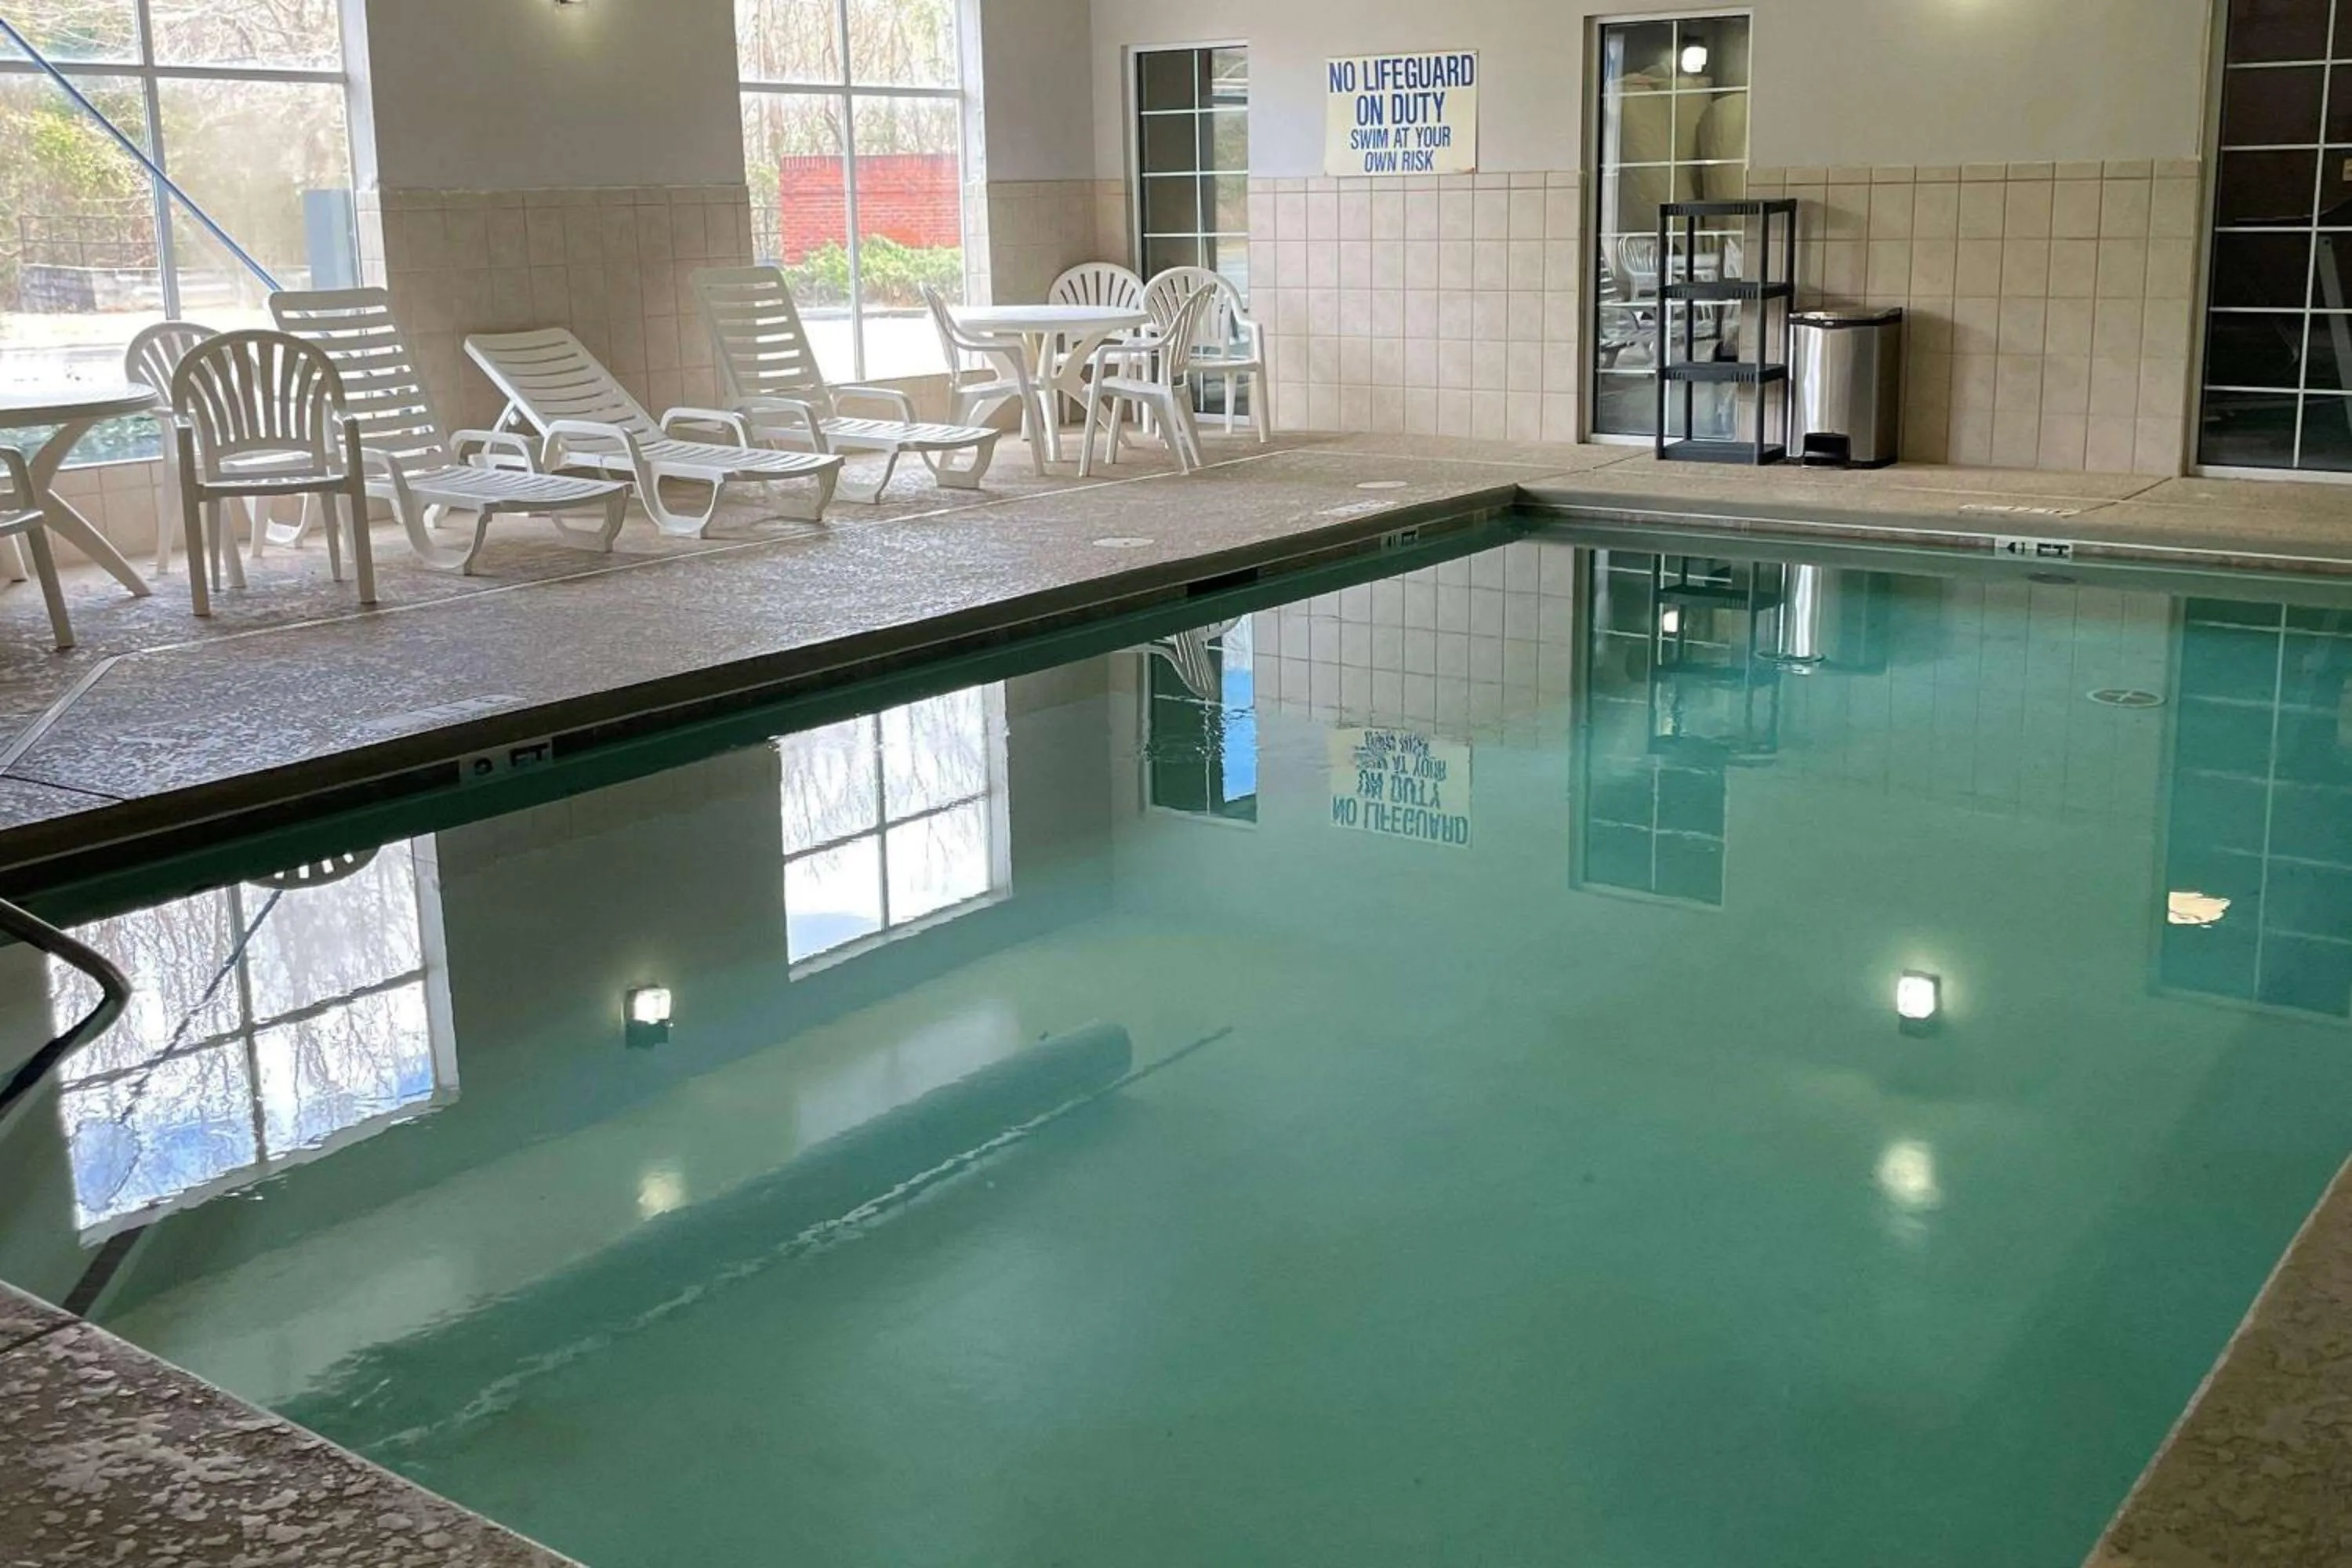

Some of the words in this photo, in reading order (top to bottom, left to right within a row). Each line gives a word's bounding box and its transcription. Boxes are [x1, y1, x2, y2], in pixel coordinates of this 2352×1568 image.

[1329, 61, 1356, 93] NO
[1363, 54, 1475, 92] LIFEGUARD
[1356, 94, 1384, 126] ON
[1391, 92, 1445, 125] DUTY
[1350, 128, 1388, 150] SWIM
[1393, 127, 1410, 148] AT
[1414, 125, 1451, 148] YOUR
[1364, 151, 1396, 172] OWN
[1402, 150, 1434, 172] RISK
